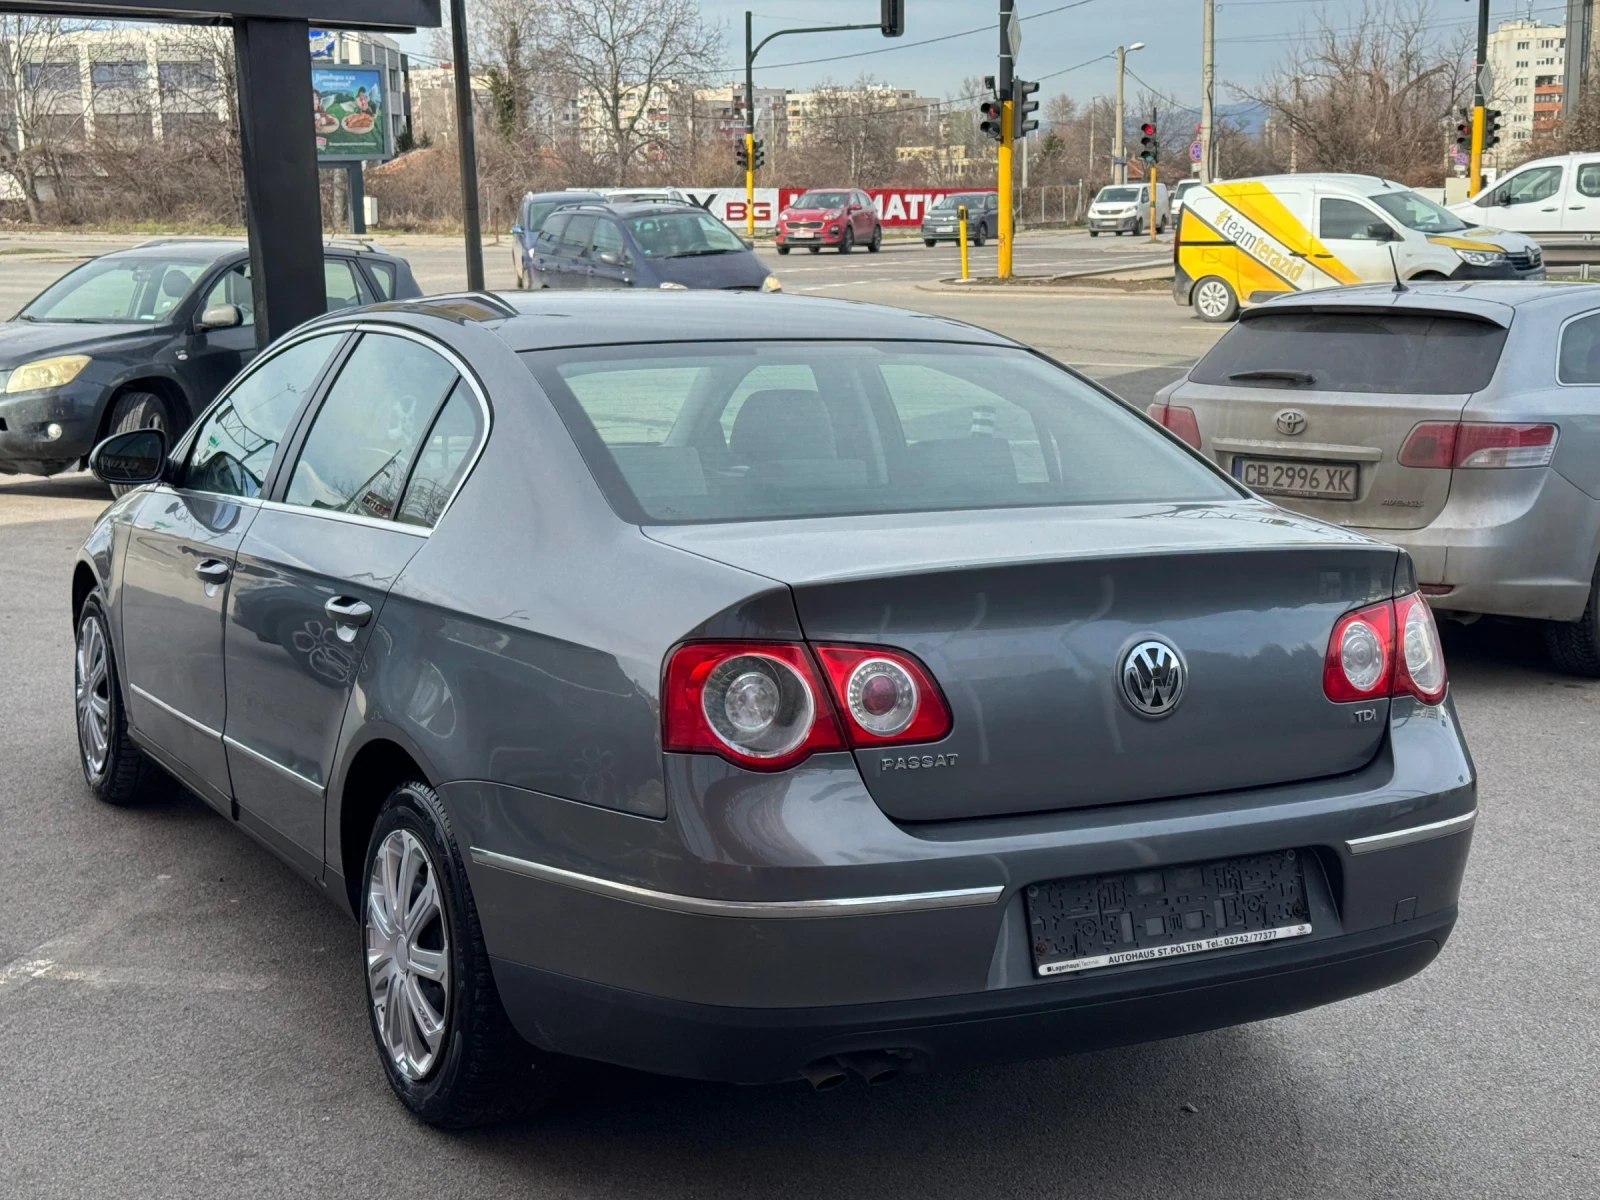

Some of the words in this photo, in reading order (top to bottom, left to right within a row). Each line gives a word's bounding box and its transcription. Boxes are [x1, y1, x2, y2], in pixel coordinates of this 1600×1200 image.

[1213, 208, 1306, 283] #teamterazid
[1244, 464, 1269, 486] CB
[1272, 466, 1320, 490] 2996
[1325, 469, 1353, 492] XK
[1354, 708, 1377, 722] TDI
[881, 753, 958, 771] PASSAT
[1108, 950, 1155, 964] AUTOHAUS
[1206, 939, 1223, 949] Tel.:
[1224, 930, 1277, 945] 02742/77377
